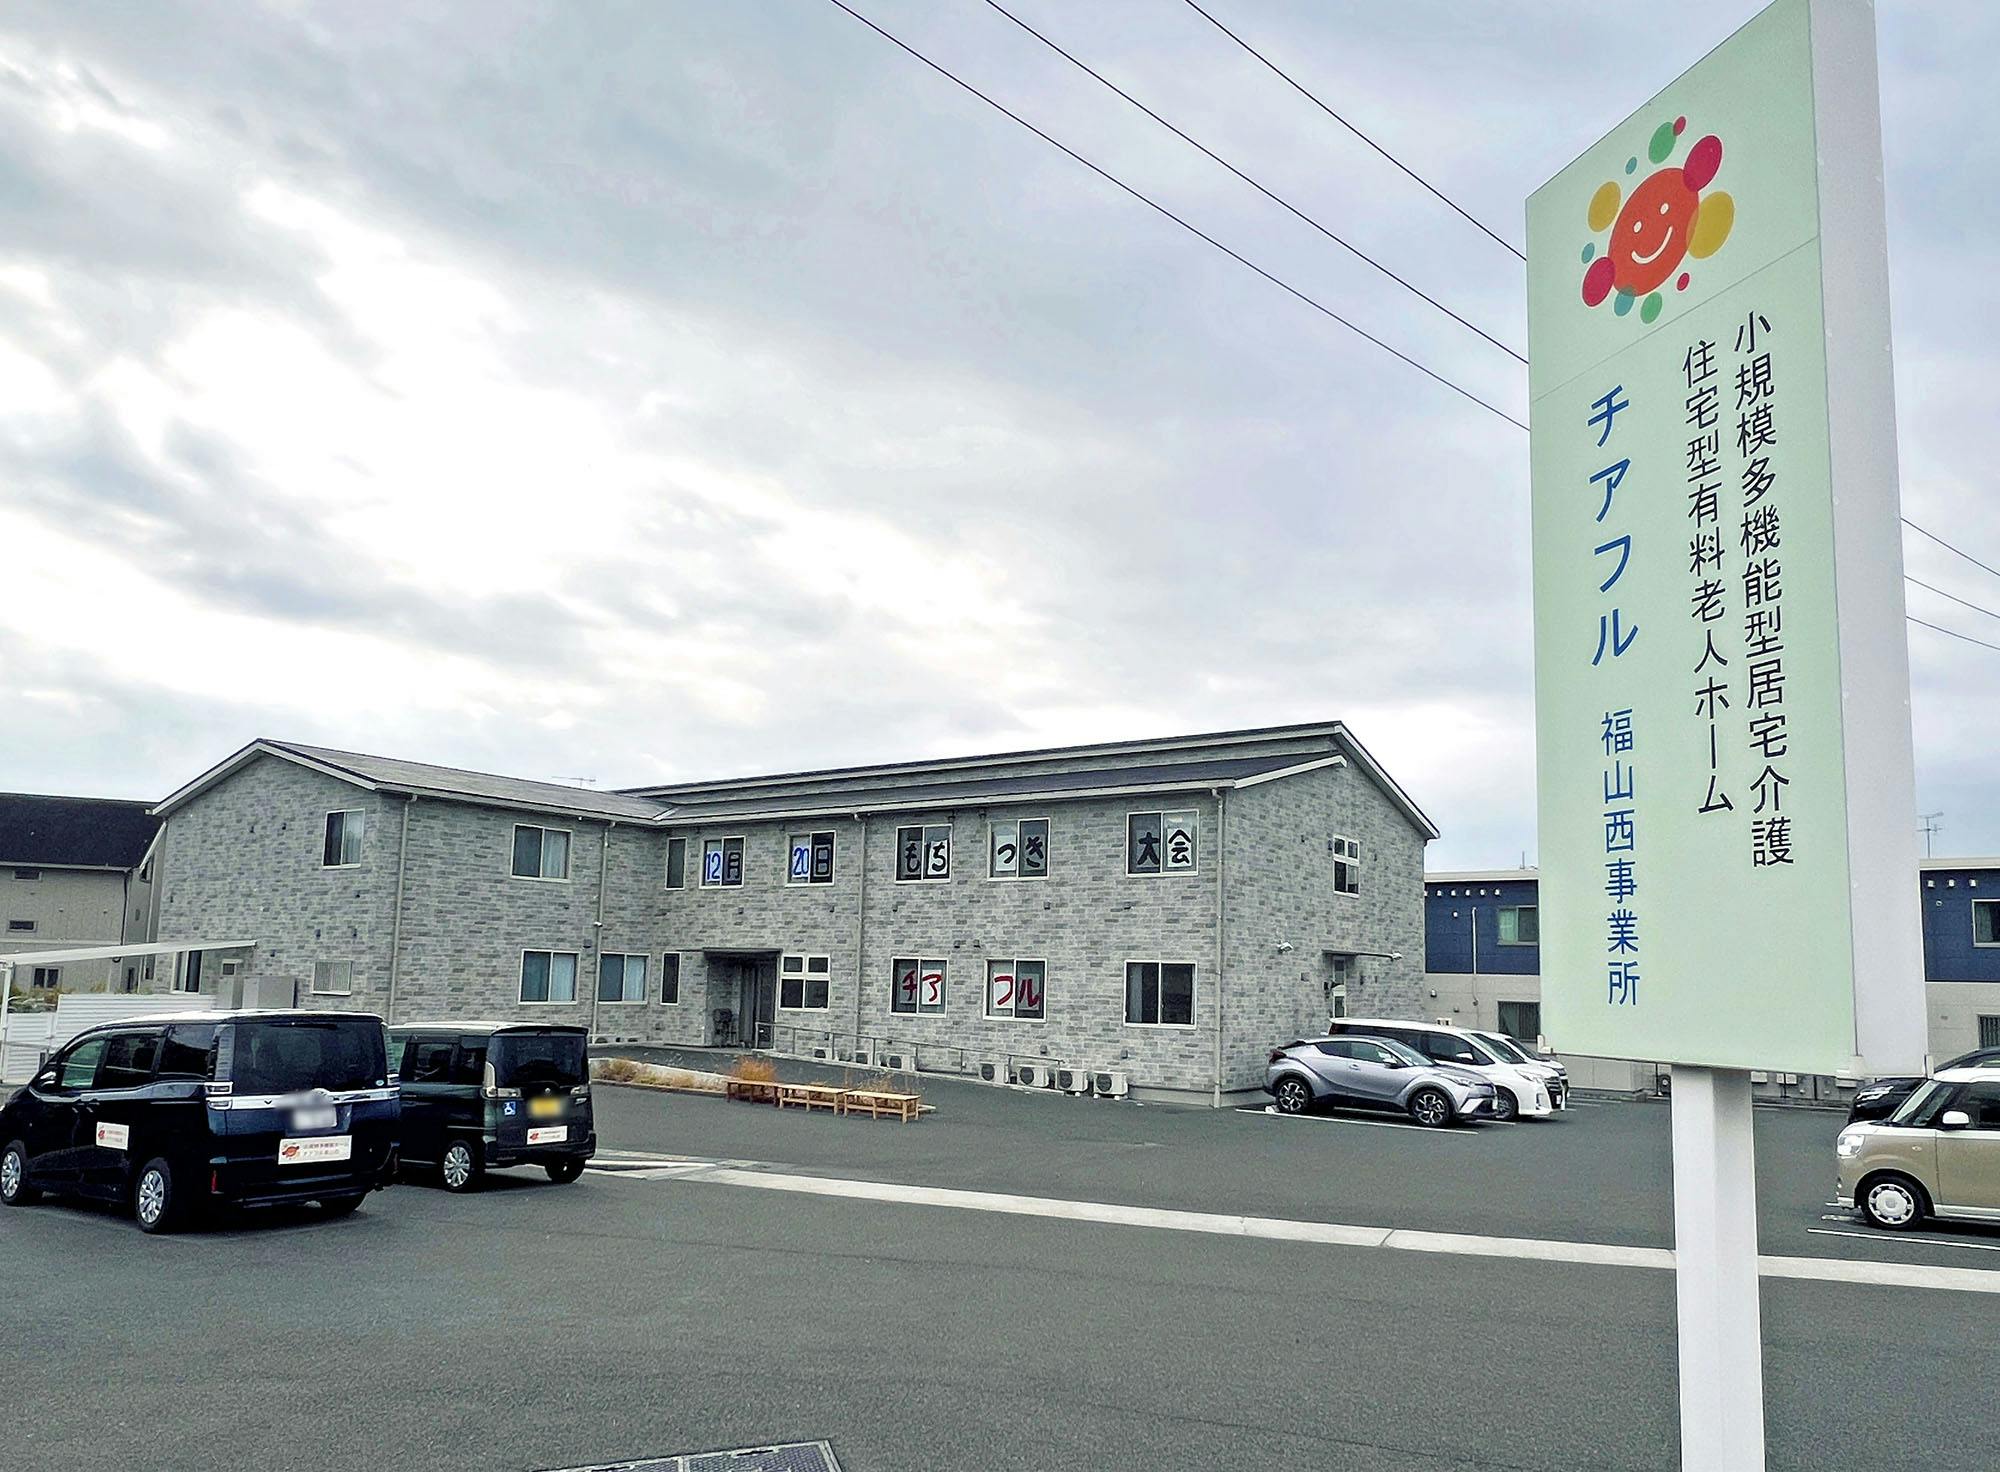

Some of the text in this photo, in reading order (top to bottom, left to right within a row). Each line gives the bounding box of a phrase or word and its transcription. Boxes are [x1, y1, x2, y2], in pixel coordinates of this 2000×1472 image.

[1586, 384, 1641, 1006] チアフル 福山西事業所
[1682, 339, 1735, 815] 住宅型有料老人ホーム
[1733, 310, 1795, 868] 小規模多機能型居宅介護
[705, 828, 1192, 881] 12月 20日 もち つき 大会
